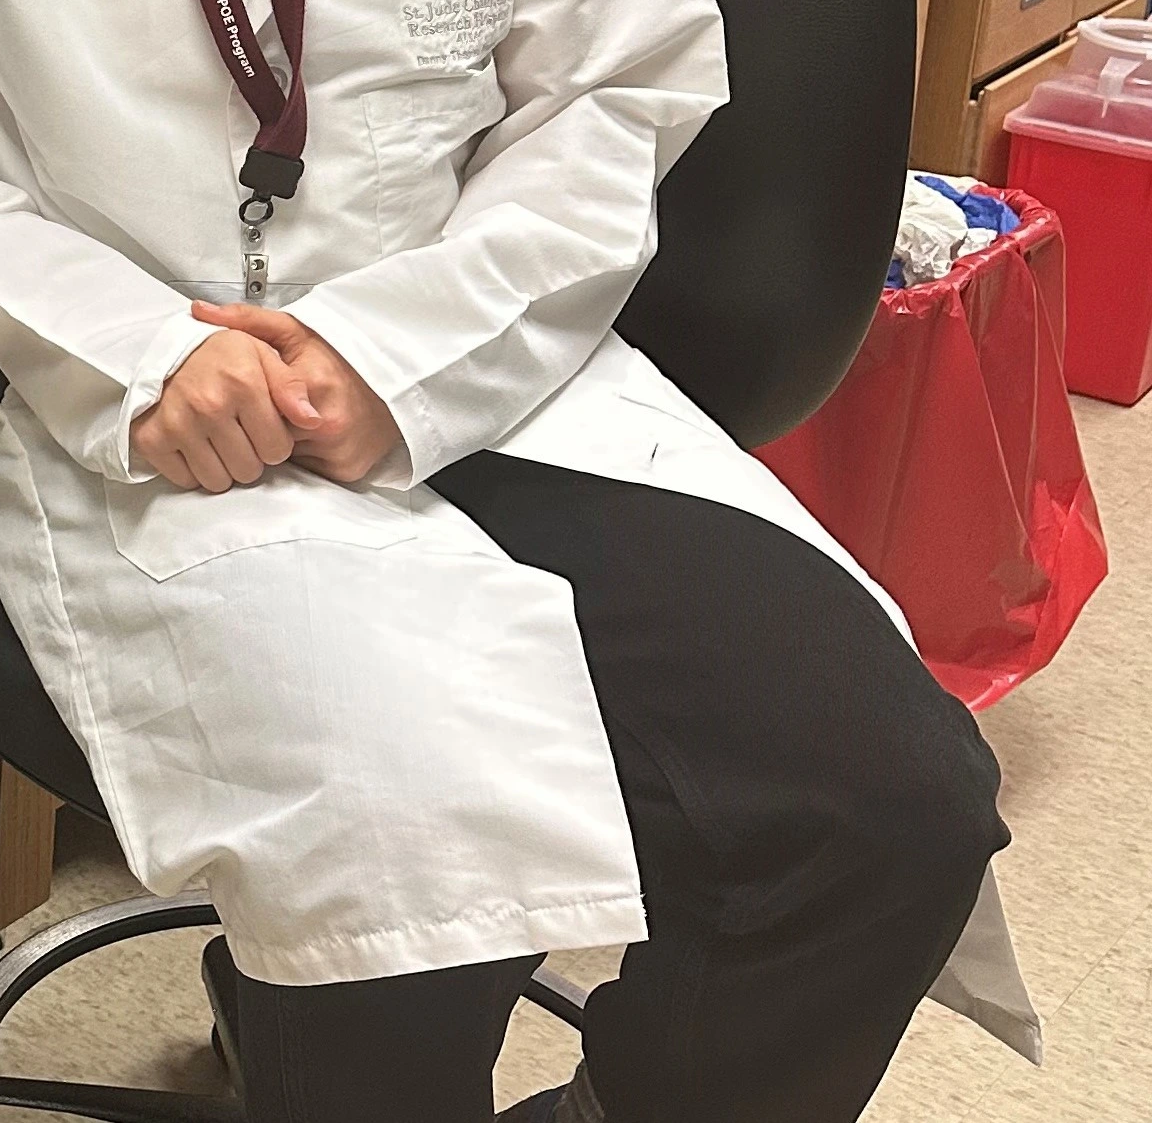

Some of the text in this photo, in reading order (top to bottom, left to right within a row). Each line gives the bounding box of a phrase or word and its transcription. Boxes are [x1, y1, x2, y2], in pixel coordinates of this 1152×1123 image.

[425, 0, 461, 22] Jude
[408, 15, 472, 38] Research
[227, 25, 255, 78] Program
